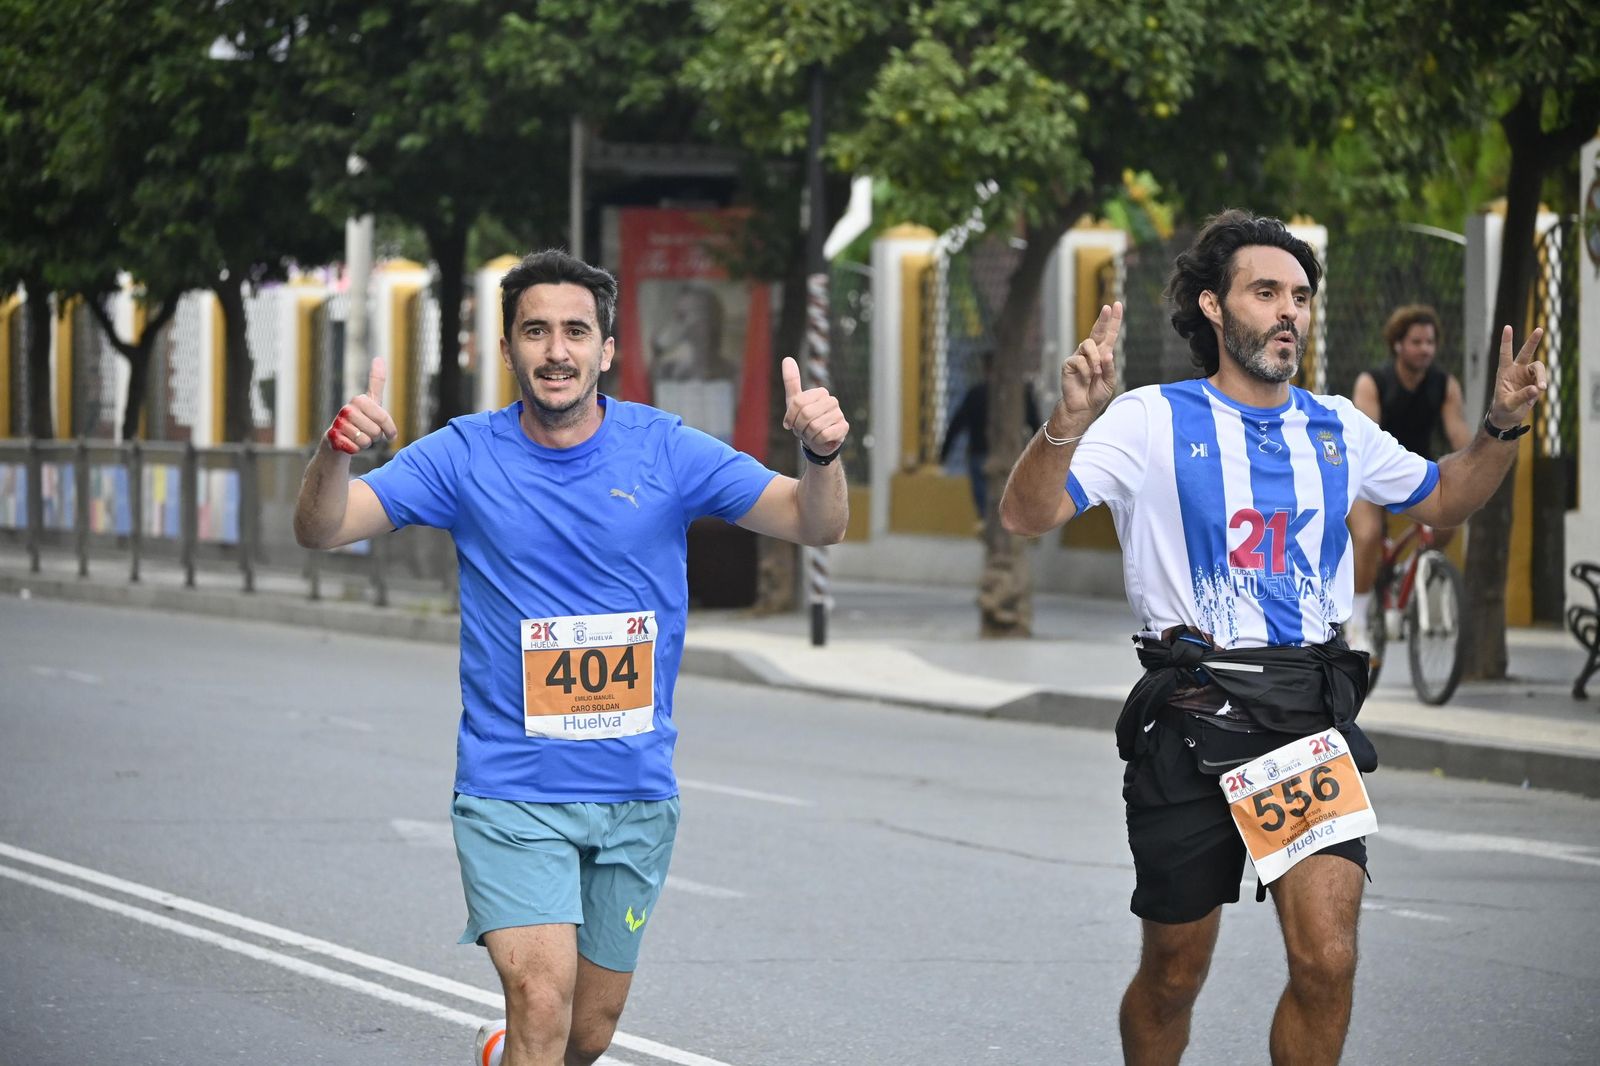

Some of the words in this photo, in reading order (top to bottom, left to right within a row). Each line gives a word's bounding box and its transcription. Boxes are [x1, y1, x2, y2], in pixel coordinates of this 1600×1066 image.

[1232, 575, 1318, 601] HUELVA
[530, 641, 559, 649] HUELVA
[626, 634, 649, 643] HUELVA
[545, 646, 639, 694] 404
[570, 704, 590, 713] CARO
[591, 703, 620, 712] SOLDAN
[563, 713, 622, 731] Huelva
[1314, 748, 1341, 764] HUELVA
[1281, 762, 1302, 774] HUELVA
[1230, 785, 1257, 801] HUELVA
[1252, 765, 1340, 832] 556
[1306, 809, 1338, 827] ESCOBAR
[1286, 825, 1335, 859] Huelva
